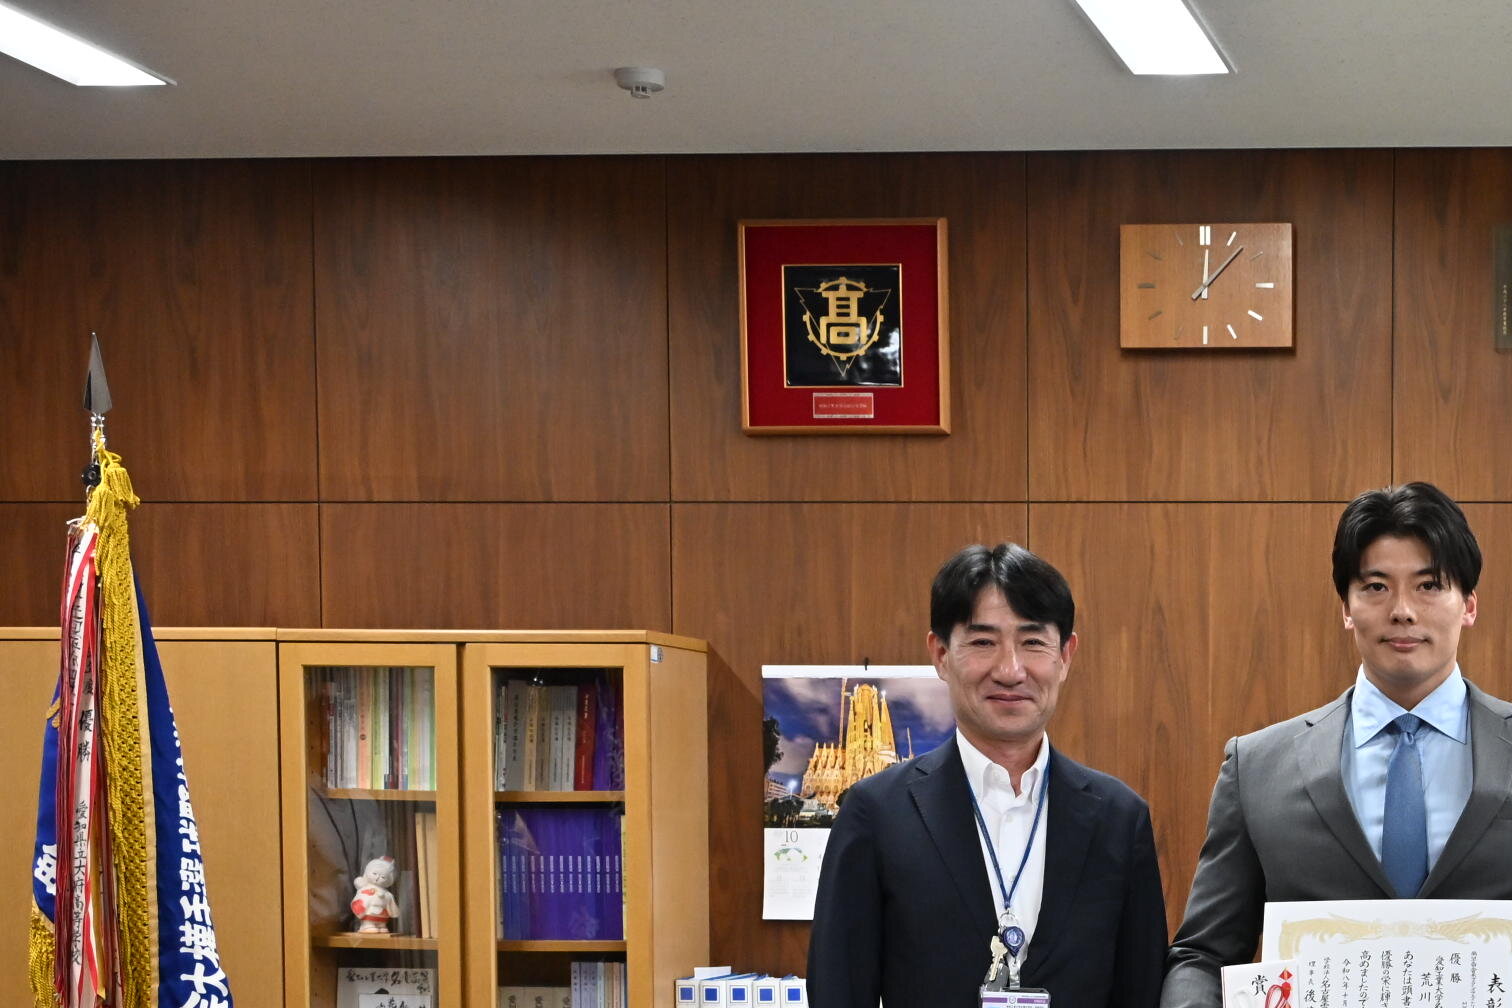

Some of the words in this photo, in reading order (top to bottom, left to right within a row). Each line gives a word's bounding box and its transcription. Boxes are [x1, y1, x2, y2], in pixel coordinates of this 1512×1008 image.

[785, 830, 799, 843] 10
[1450, 952, 1462, 984] 優勝
[1252, 974, 1269, 996] 賞
